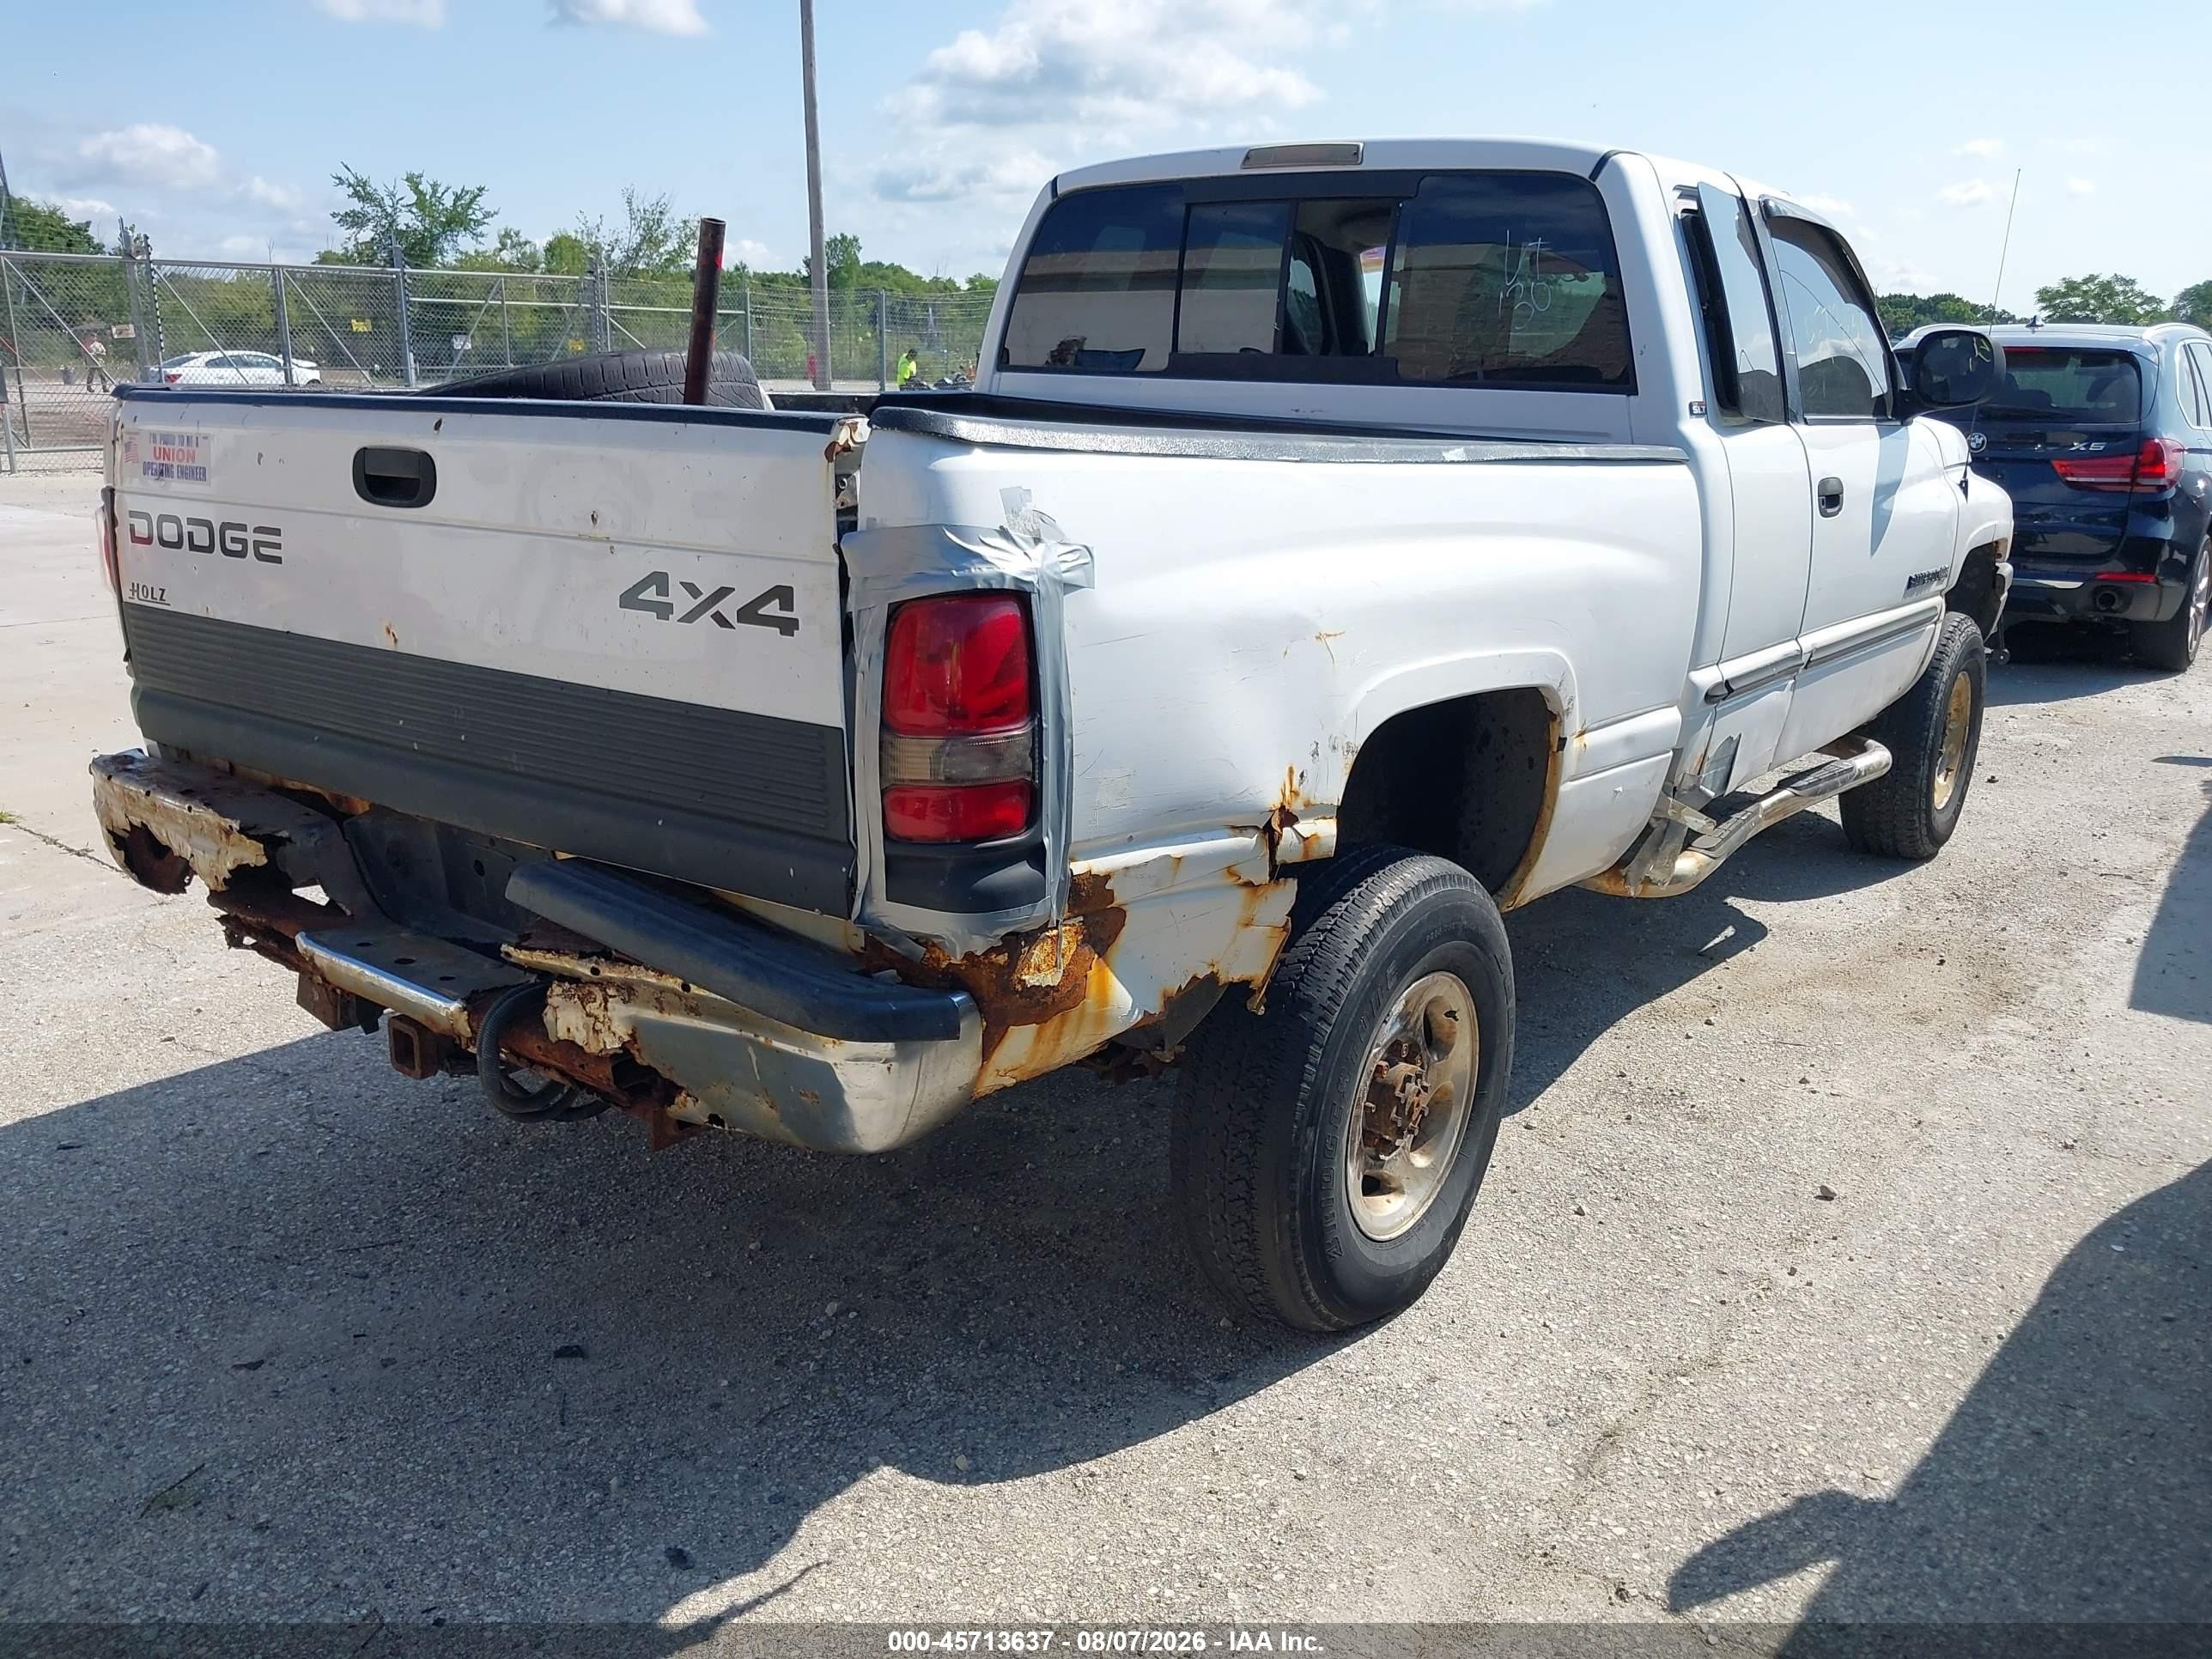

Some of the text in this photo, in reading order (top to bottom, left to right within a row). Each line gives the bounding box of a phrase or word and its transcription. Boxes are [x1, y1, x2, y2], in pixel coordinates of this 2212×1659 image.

[153, 446, 196, 464] UNION
[2069, 441, 2107, 451] X5
[177, 465, 207, 482] ENGINEER
[129, 510, 283, 565] DODGE
[129, 582, 171, 606] HOLZ
